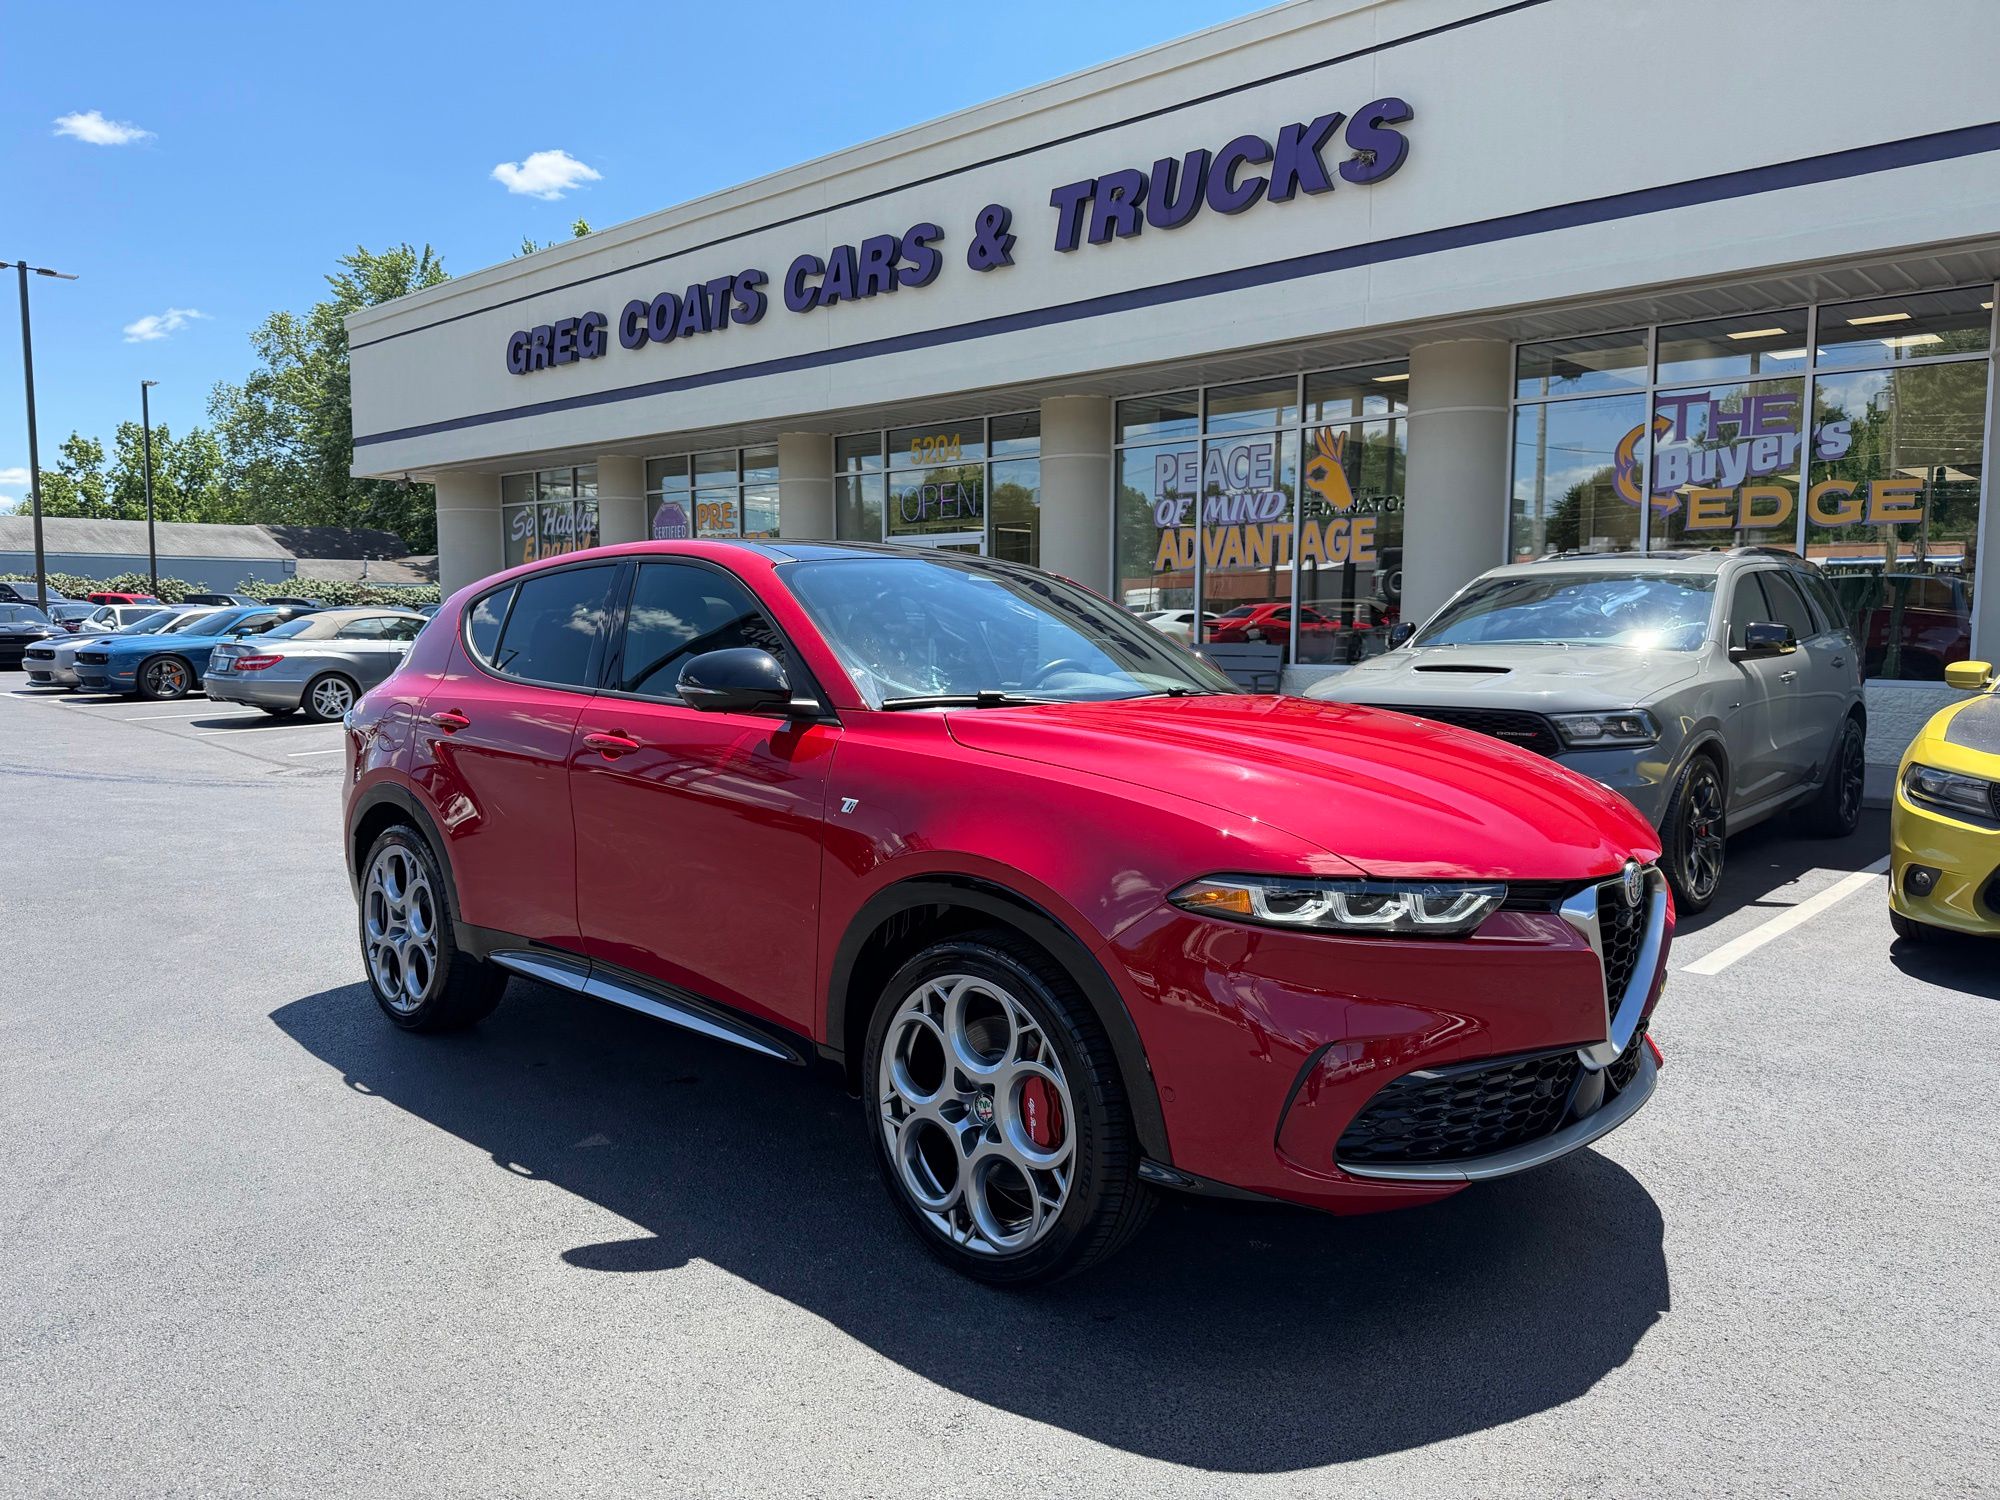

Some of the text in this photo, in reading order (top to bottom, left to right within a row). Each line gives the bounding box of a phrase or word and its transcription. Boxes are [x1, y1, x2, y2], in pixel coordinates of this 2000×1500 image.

[506, 97, 1415, 375] GREG COATS CARS & TRUCKS
[1654, 391, 1798, 443] THE
[911, 433, 961, 465] 5204
[1154, 443, 1273, 496] PEACE
[901, 481, 976, 522] OPEN
[1154, 491, 1287, 528] OF MIND
[1361, 486, 1381, 496] THE
[1684, 478, 1925, 531] EDGE
[511, 510, 534, 541] Se
[653, 525, 687, 539] CERTIFIED
[1154, 517, 1377, 571] ADVANTAGE
